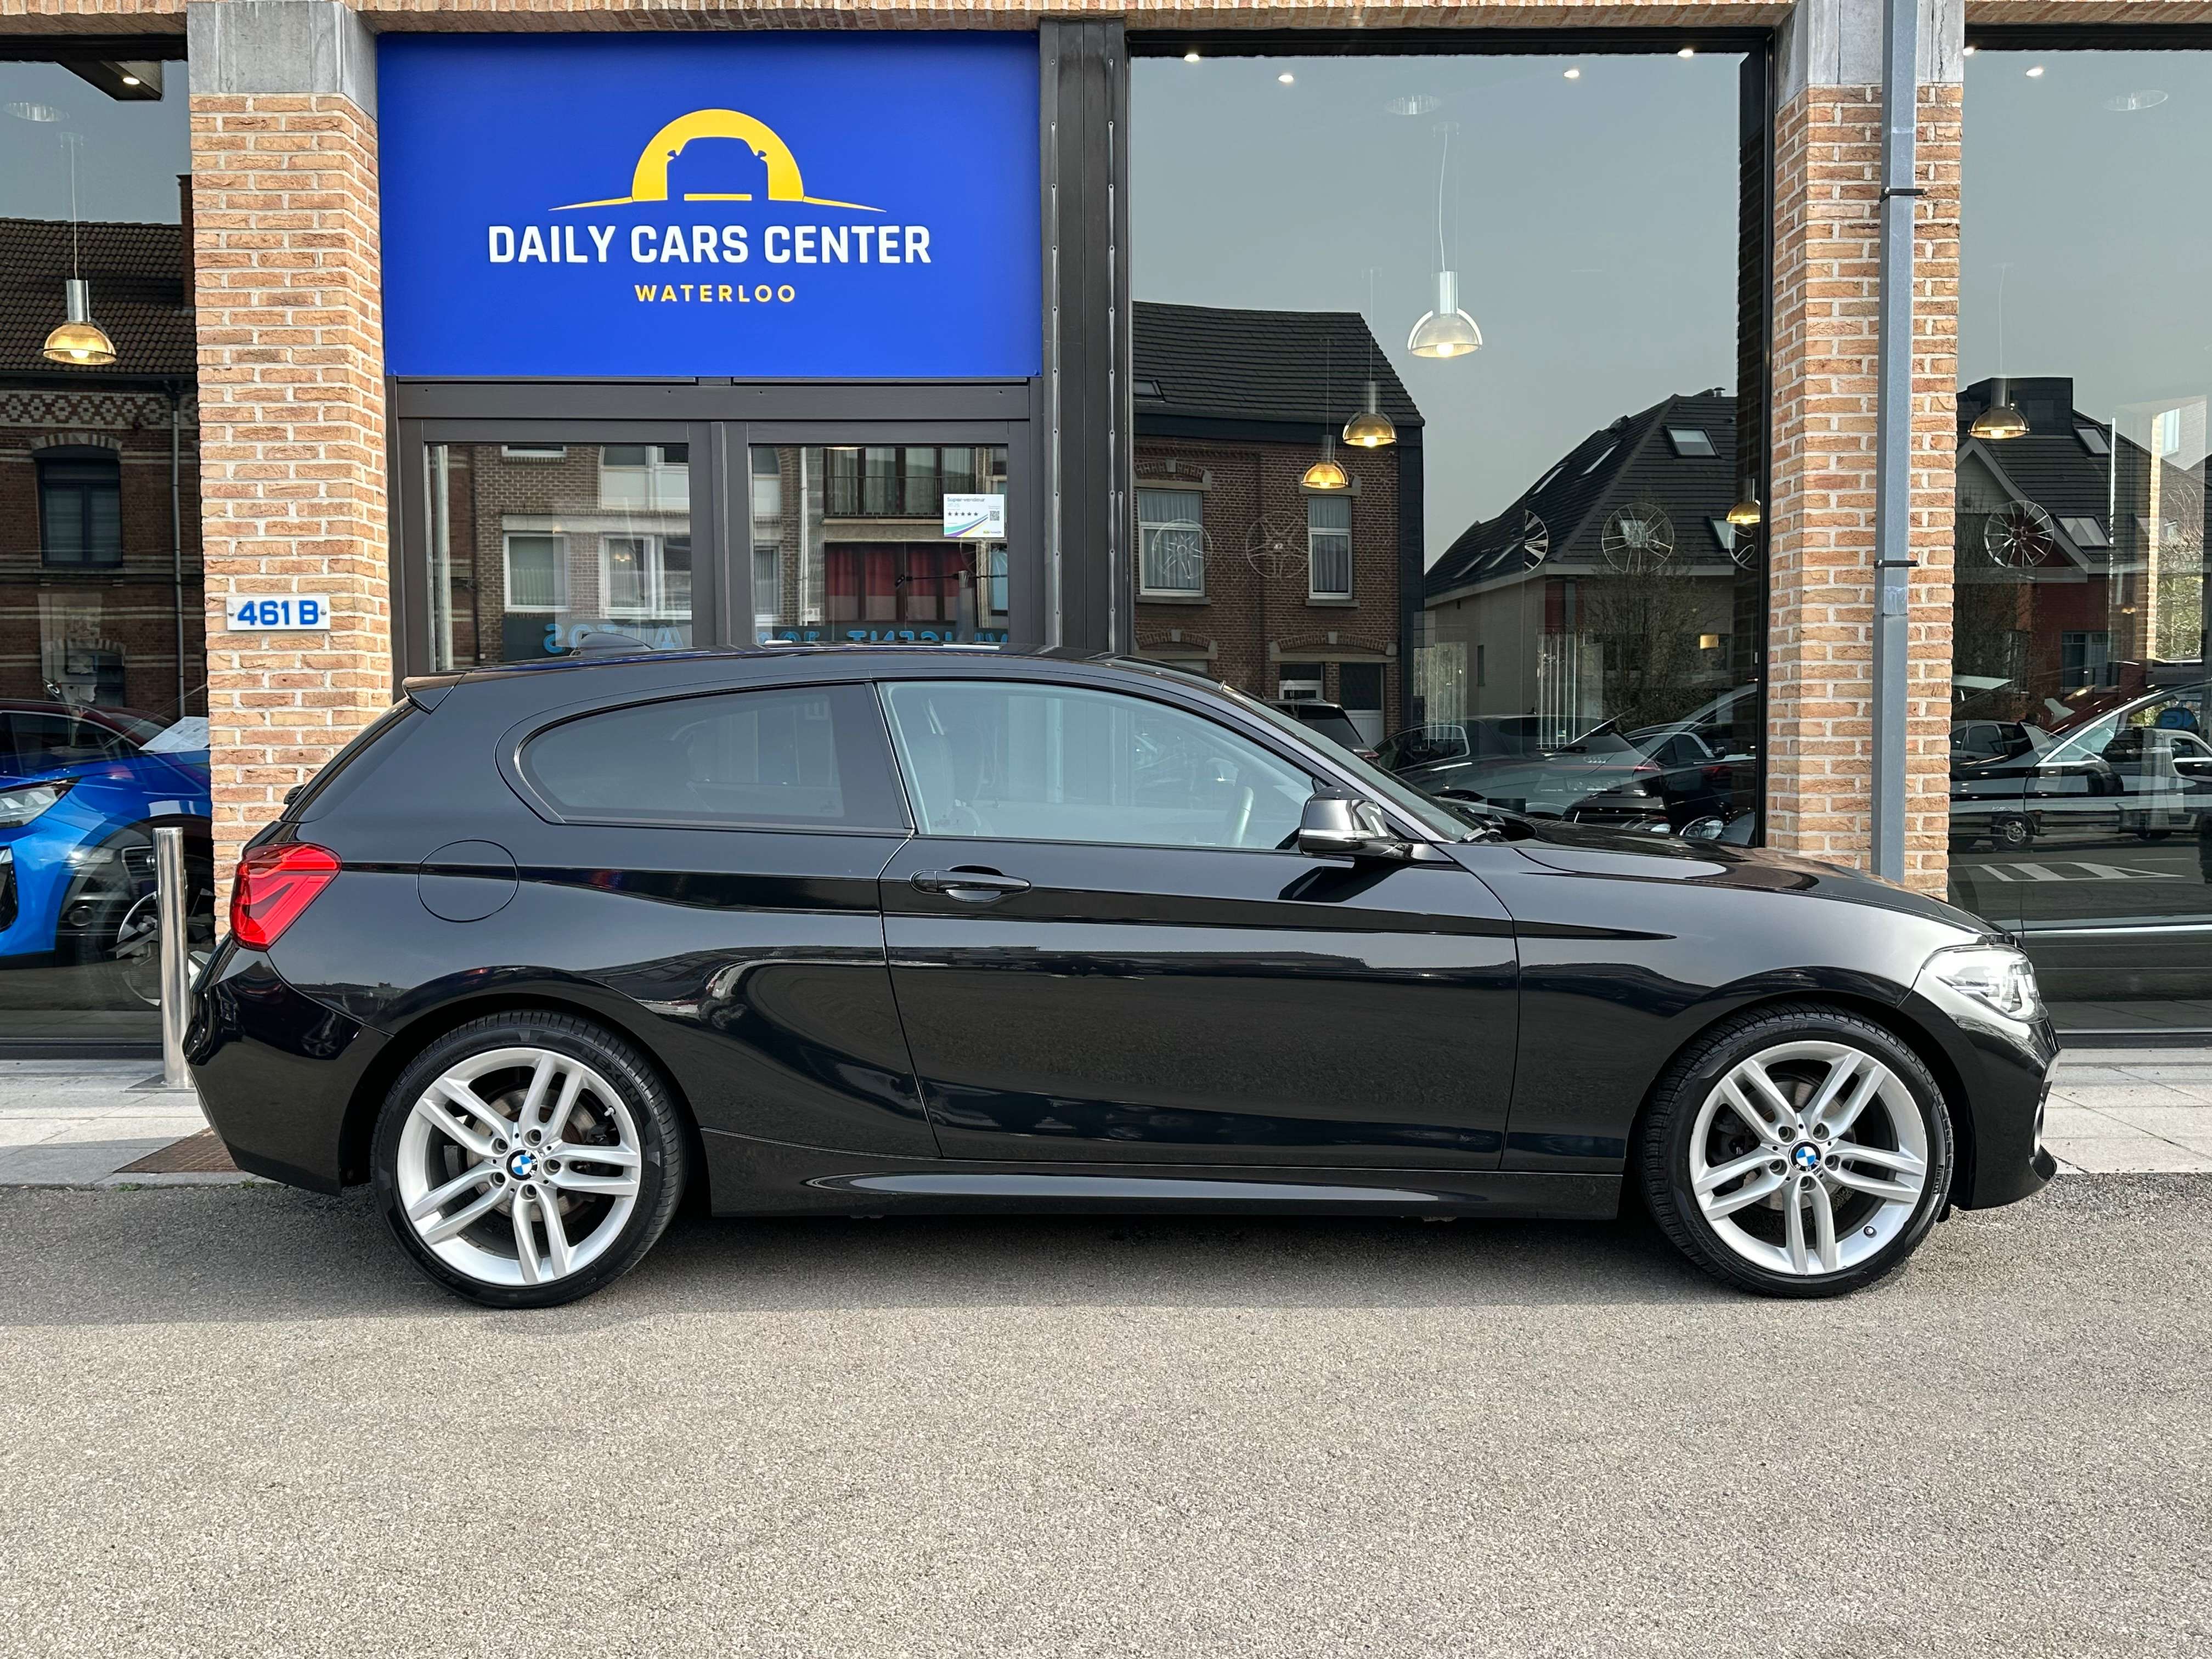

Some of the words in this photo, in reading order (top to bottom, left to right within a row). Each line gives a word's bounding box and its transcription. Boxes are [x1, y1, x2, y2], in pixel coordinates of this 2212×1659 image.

[488, 225, 616, 263] DAILY
[631, 225, 748, 263] CARS
[764, 225, 932, 263] CENTER
[635, 284, 797, 303] WATERLOO
[237, 600, 290, 625] 461
[298, 600, 319, 625] B
[580, 1046, 641, 1103] NEXEN
